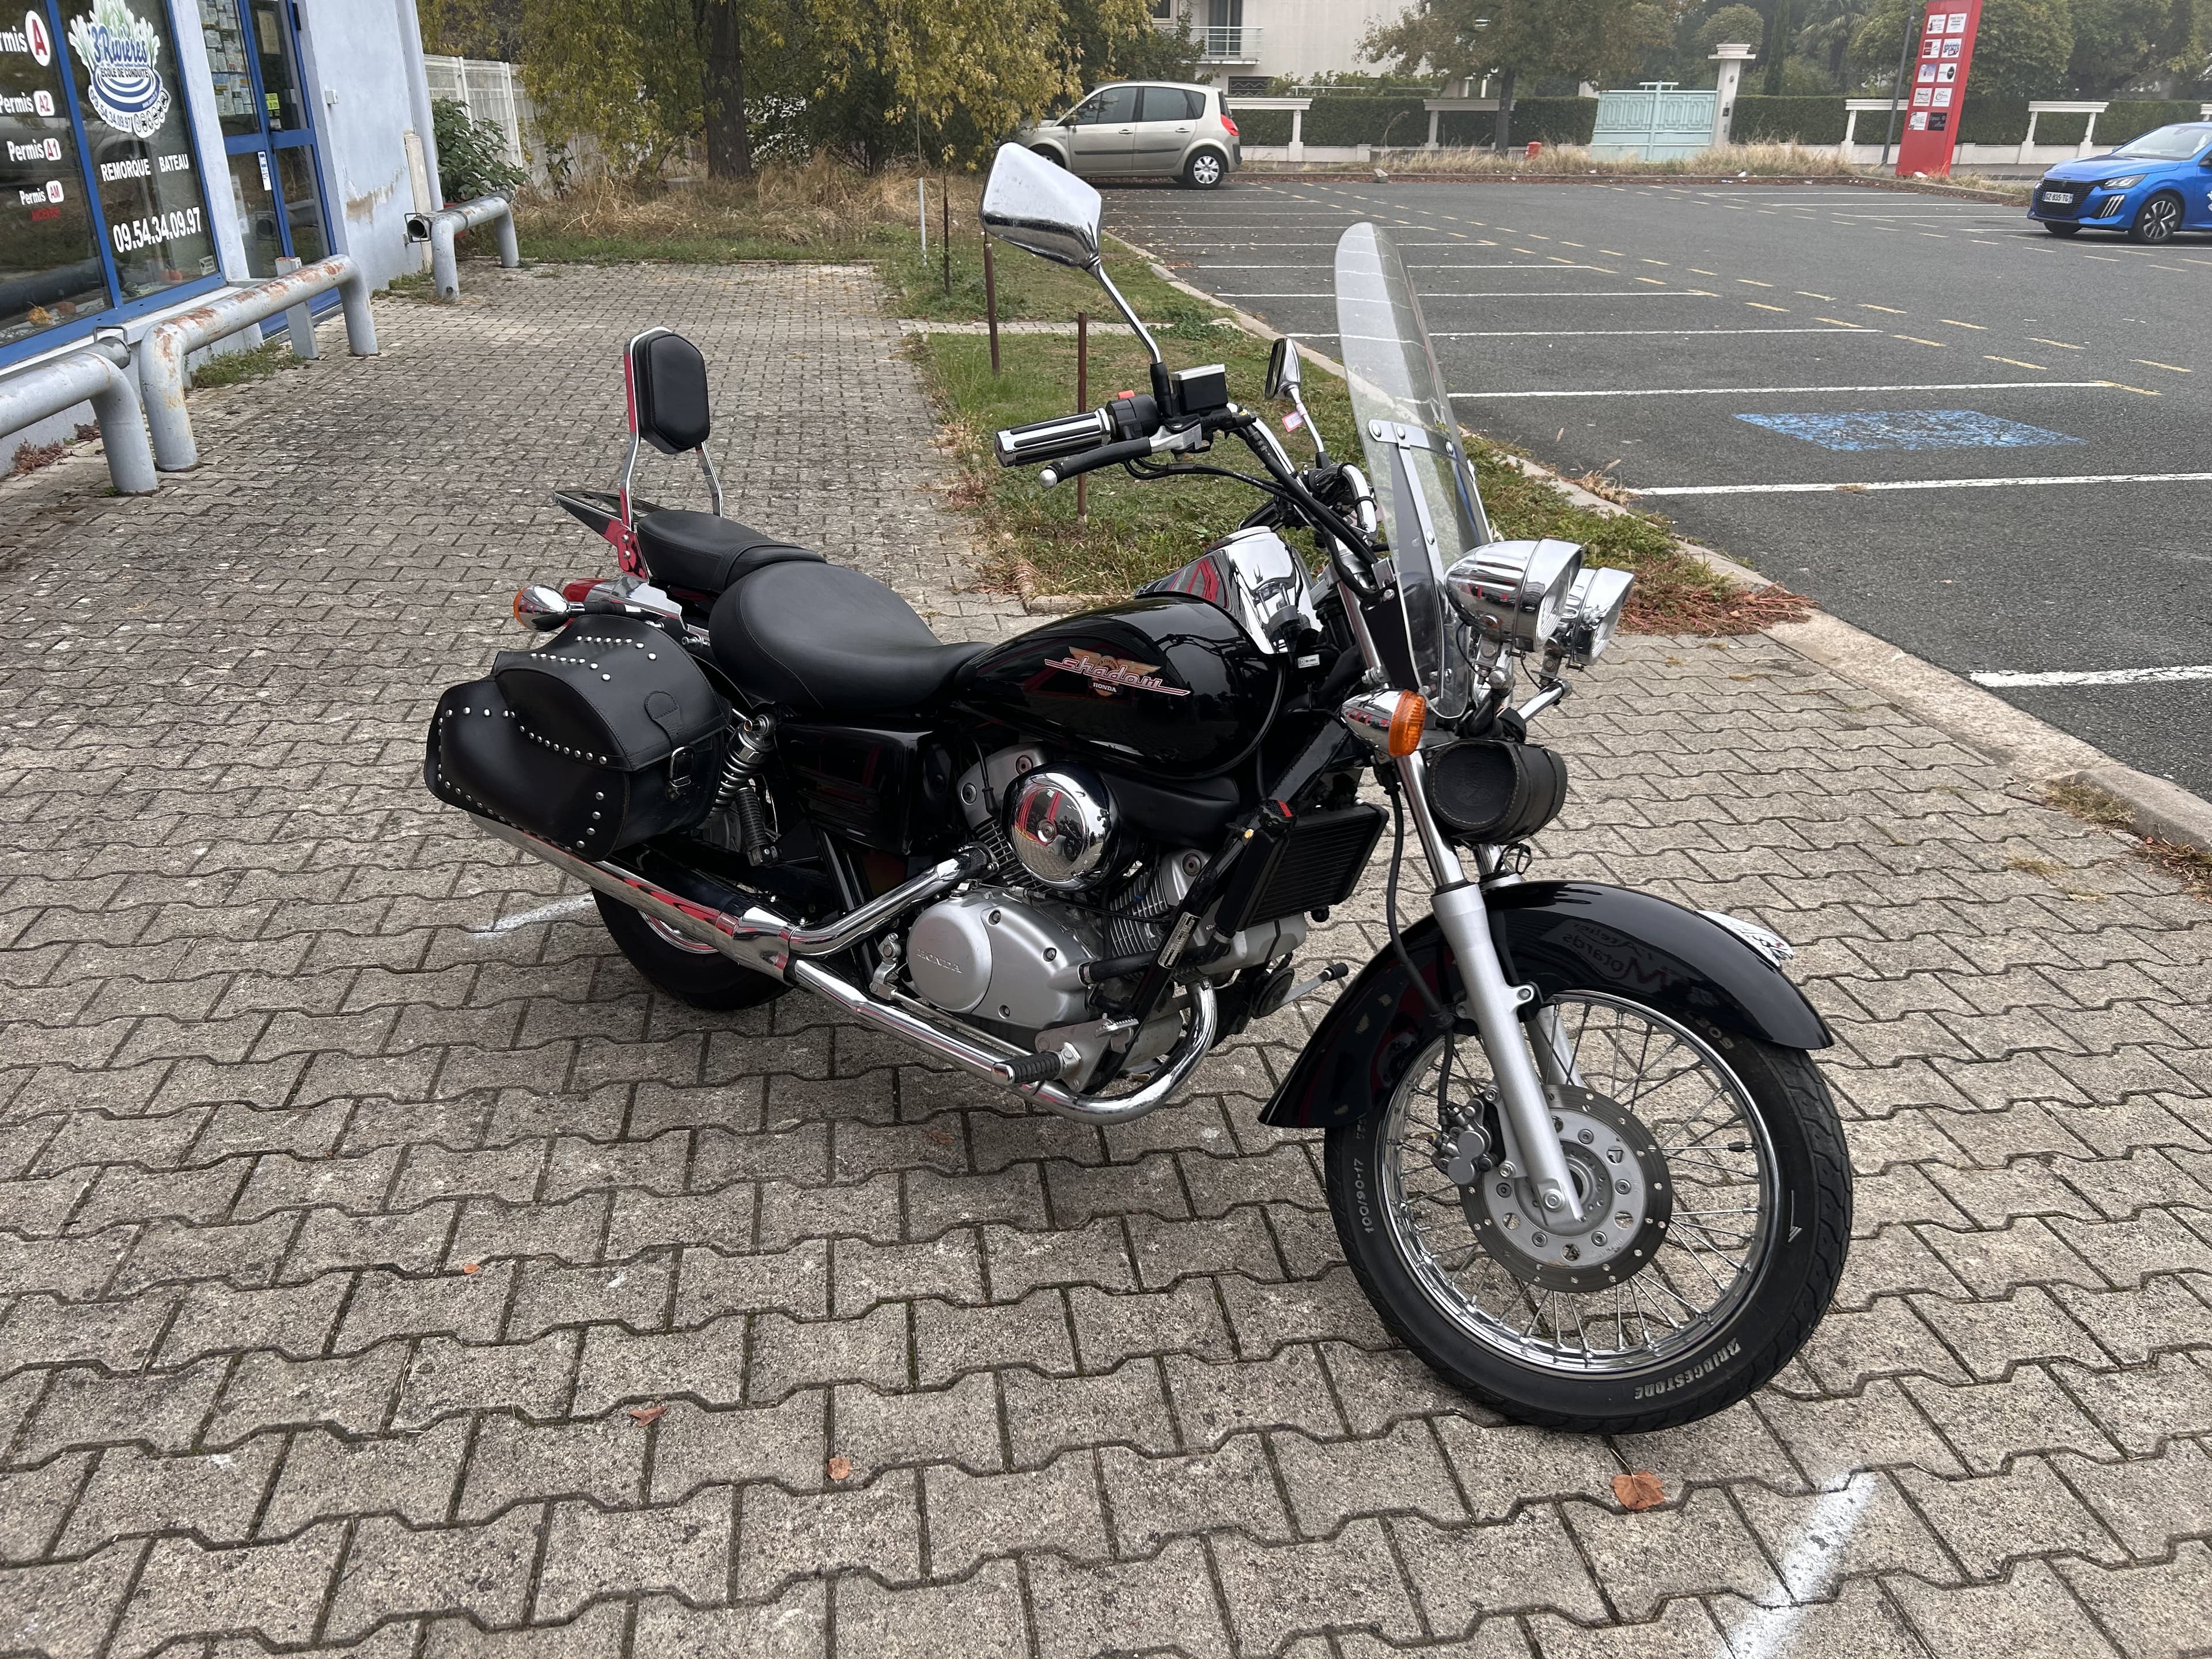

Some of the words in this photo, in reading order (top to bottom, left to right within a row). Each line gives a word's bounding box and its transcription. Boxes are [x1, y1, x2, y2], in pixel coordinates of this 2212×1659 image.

[32, 19, 48, 55] A
[117, 67, 124, 78] DE
[124, 68, 150, 78] CONDUITE
[39, 94, 51, 112] A2
[6, 138, 45, 162] Permis
[47, 140, 59, 157] A1
[100, 158, 151, 181] REMORQUE
[158, 154, 189, 173] BATEAU
[19, 187, 46, 205] Permis
[50, 185, 60, 199] AM
[112, 207, 202, 253] 09.54.34.09.97
[1092, 682, 1117, 692] HONDA
[917, 949, 963, 974] HONDA
[1353, 1157, 1374, 1234] 100/90-17
[1634, 1337, 1741, 1400] BRIDGESTONE
